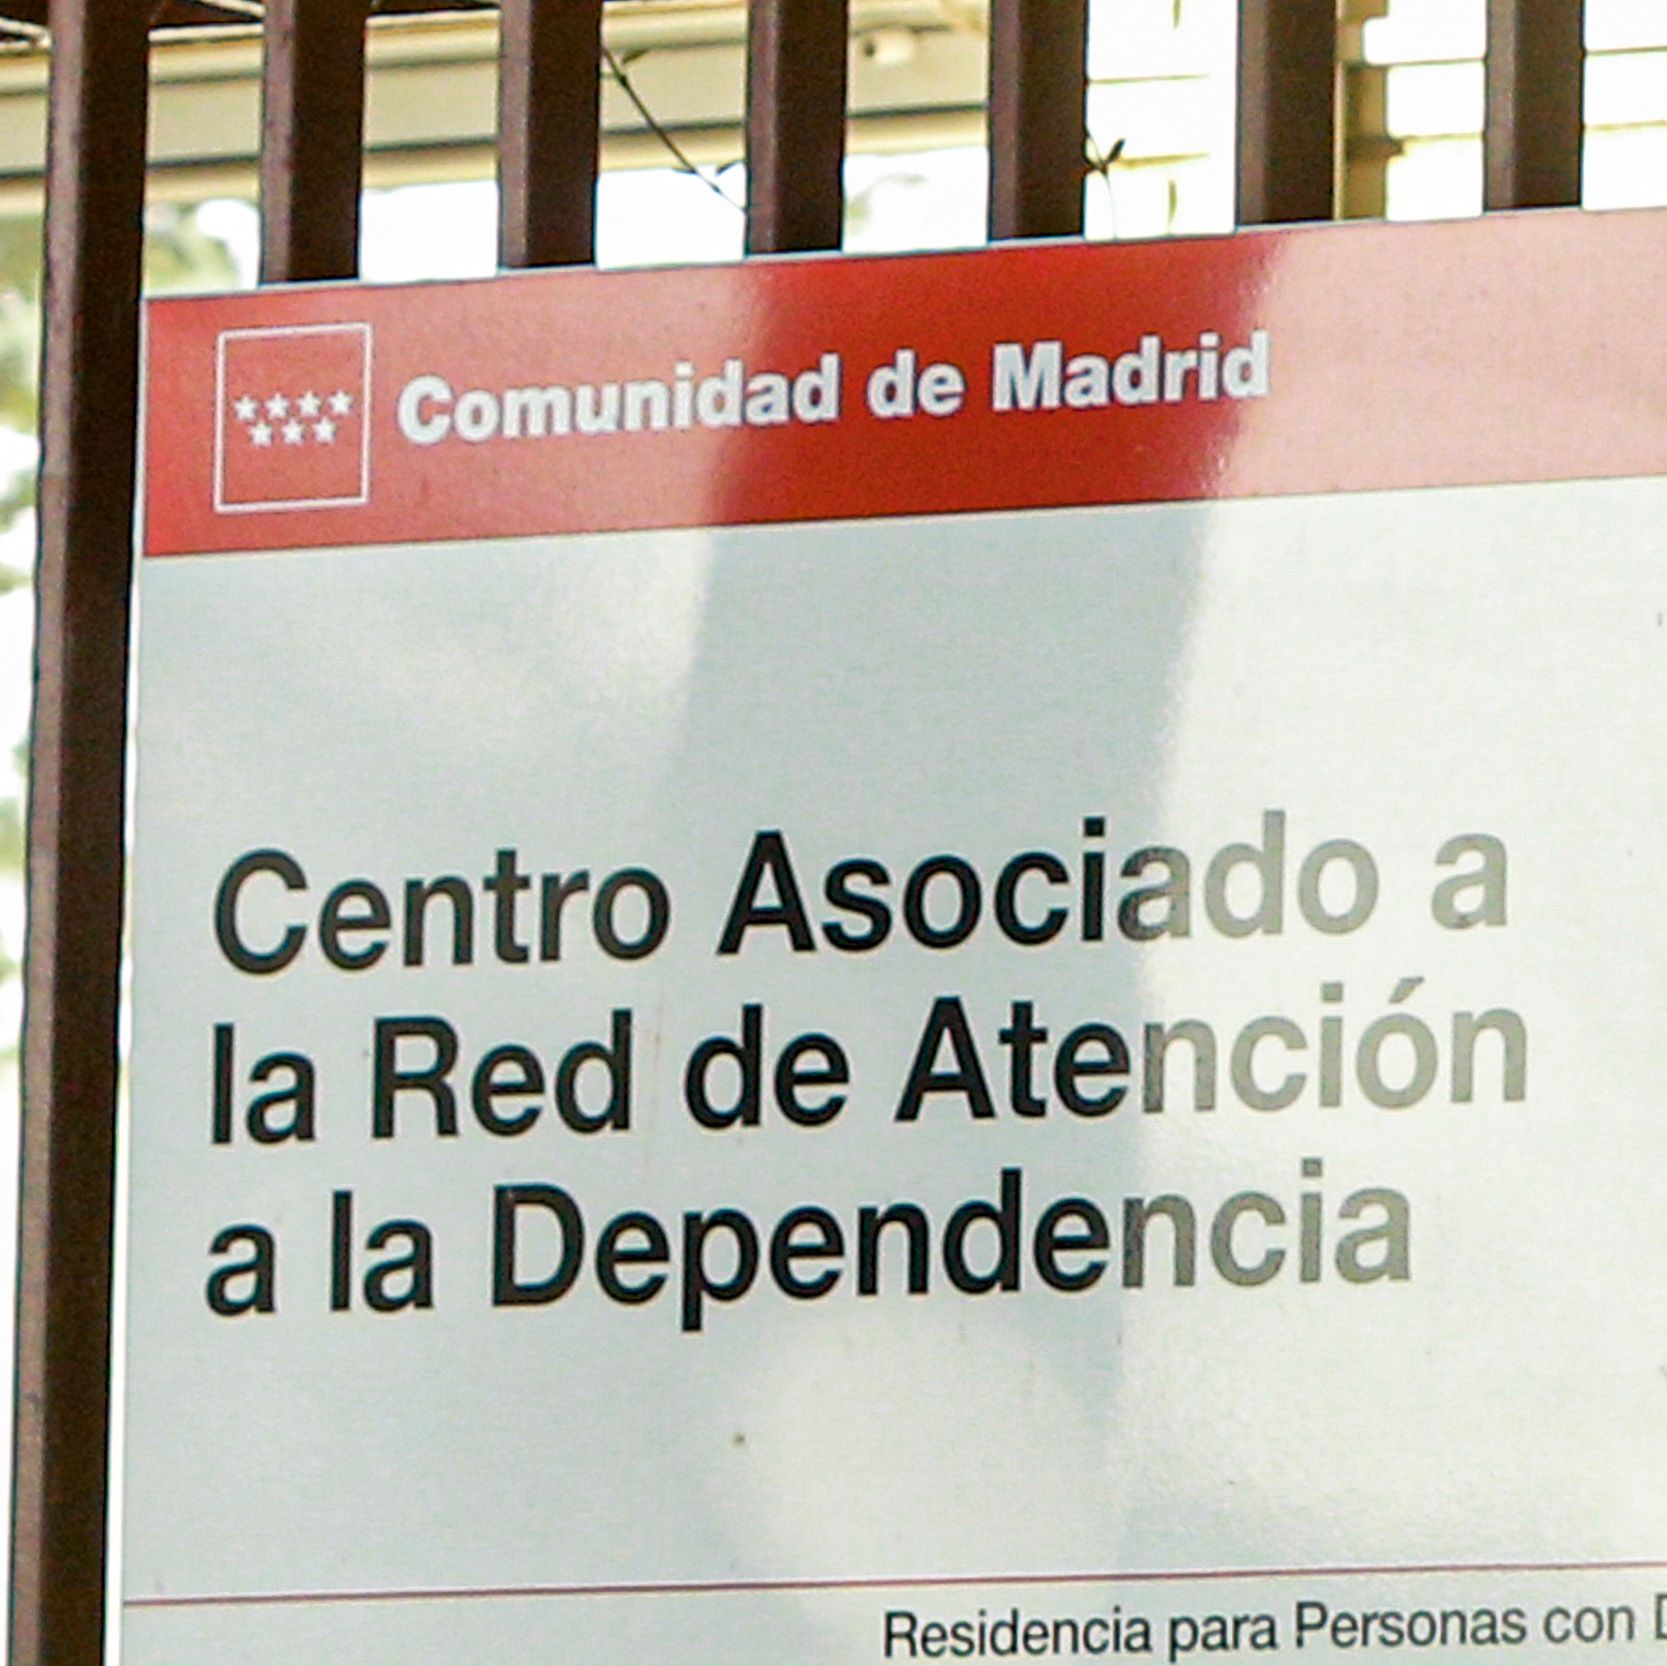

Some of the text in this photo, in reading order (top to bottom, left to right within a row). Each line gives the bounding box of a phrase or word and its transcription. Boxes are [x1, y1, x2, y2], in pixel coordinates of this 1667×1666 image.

[398, 331, 1271, 445] Comunidad de Madrid
[215, 809, 1508, 974] Centro Asociado a
[212, 977, 1527, 1145] la Red de Atención
[206, 1158, 1411, 1332] a la Dependencia
[885, 1607, 1151, 1657] Residencia
[1169, 1612, 1278, 1663] para
[1296, 1602, 1526, 1650] Personas
[1542, 1602, 1634, 1645] con
